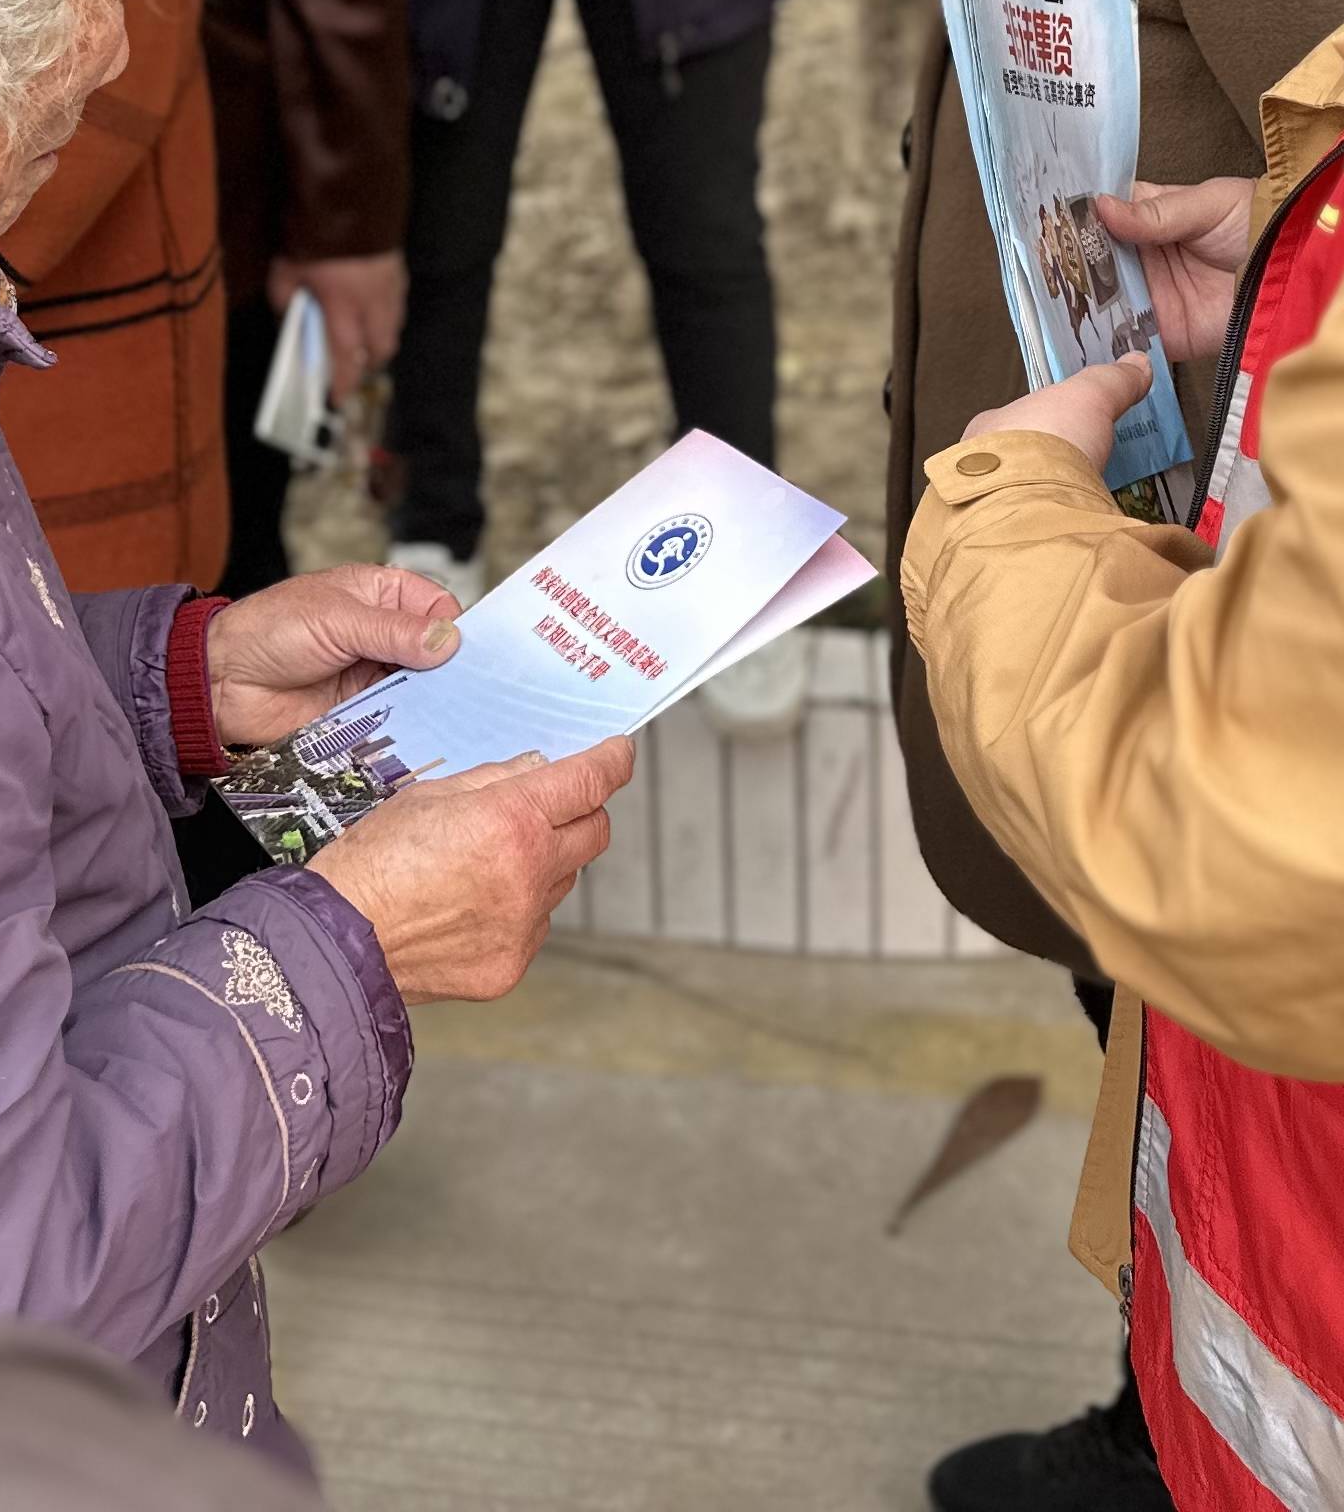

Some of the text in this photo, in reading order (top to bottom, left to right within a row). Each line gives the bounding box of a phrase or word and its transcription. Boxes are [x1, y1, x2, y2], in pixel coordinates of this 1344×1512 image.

[1002, 0, 1073, 78] 非法集资
[532, 614, 612, 682] 应知应会手册
